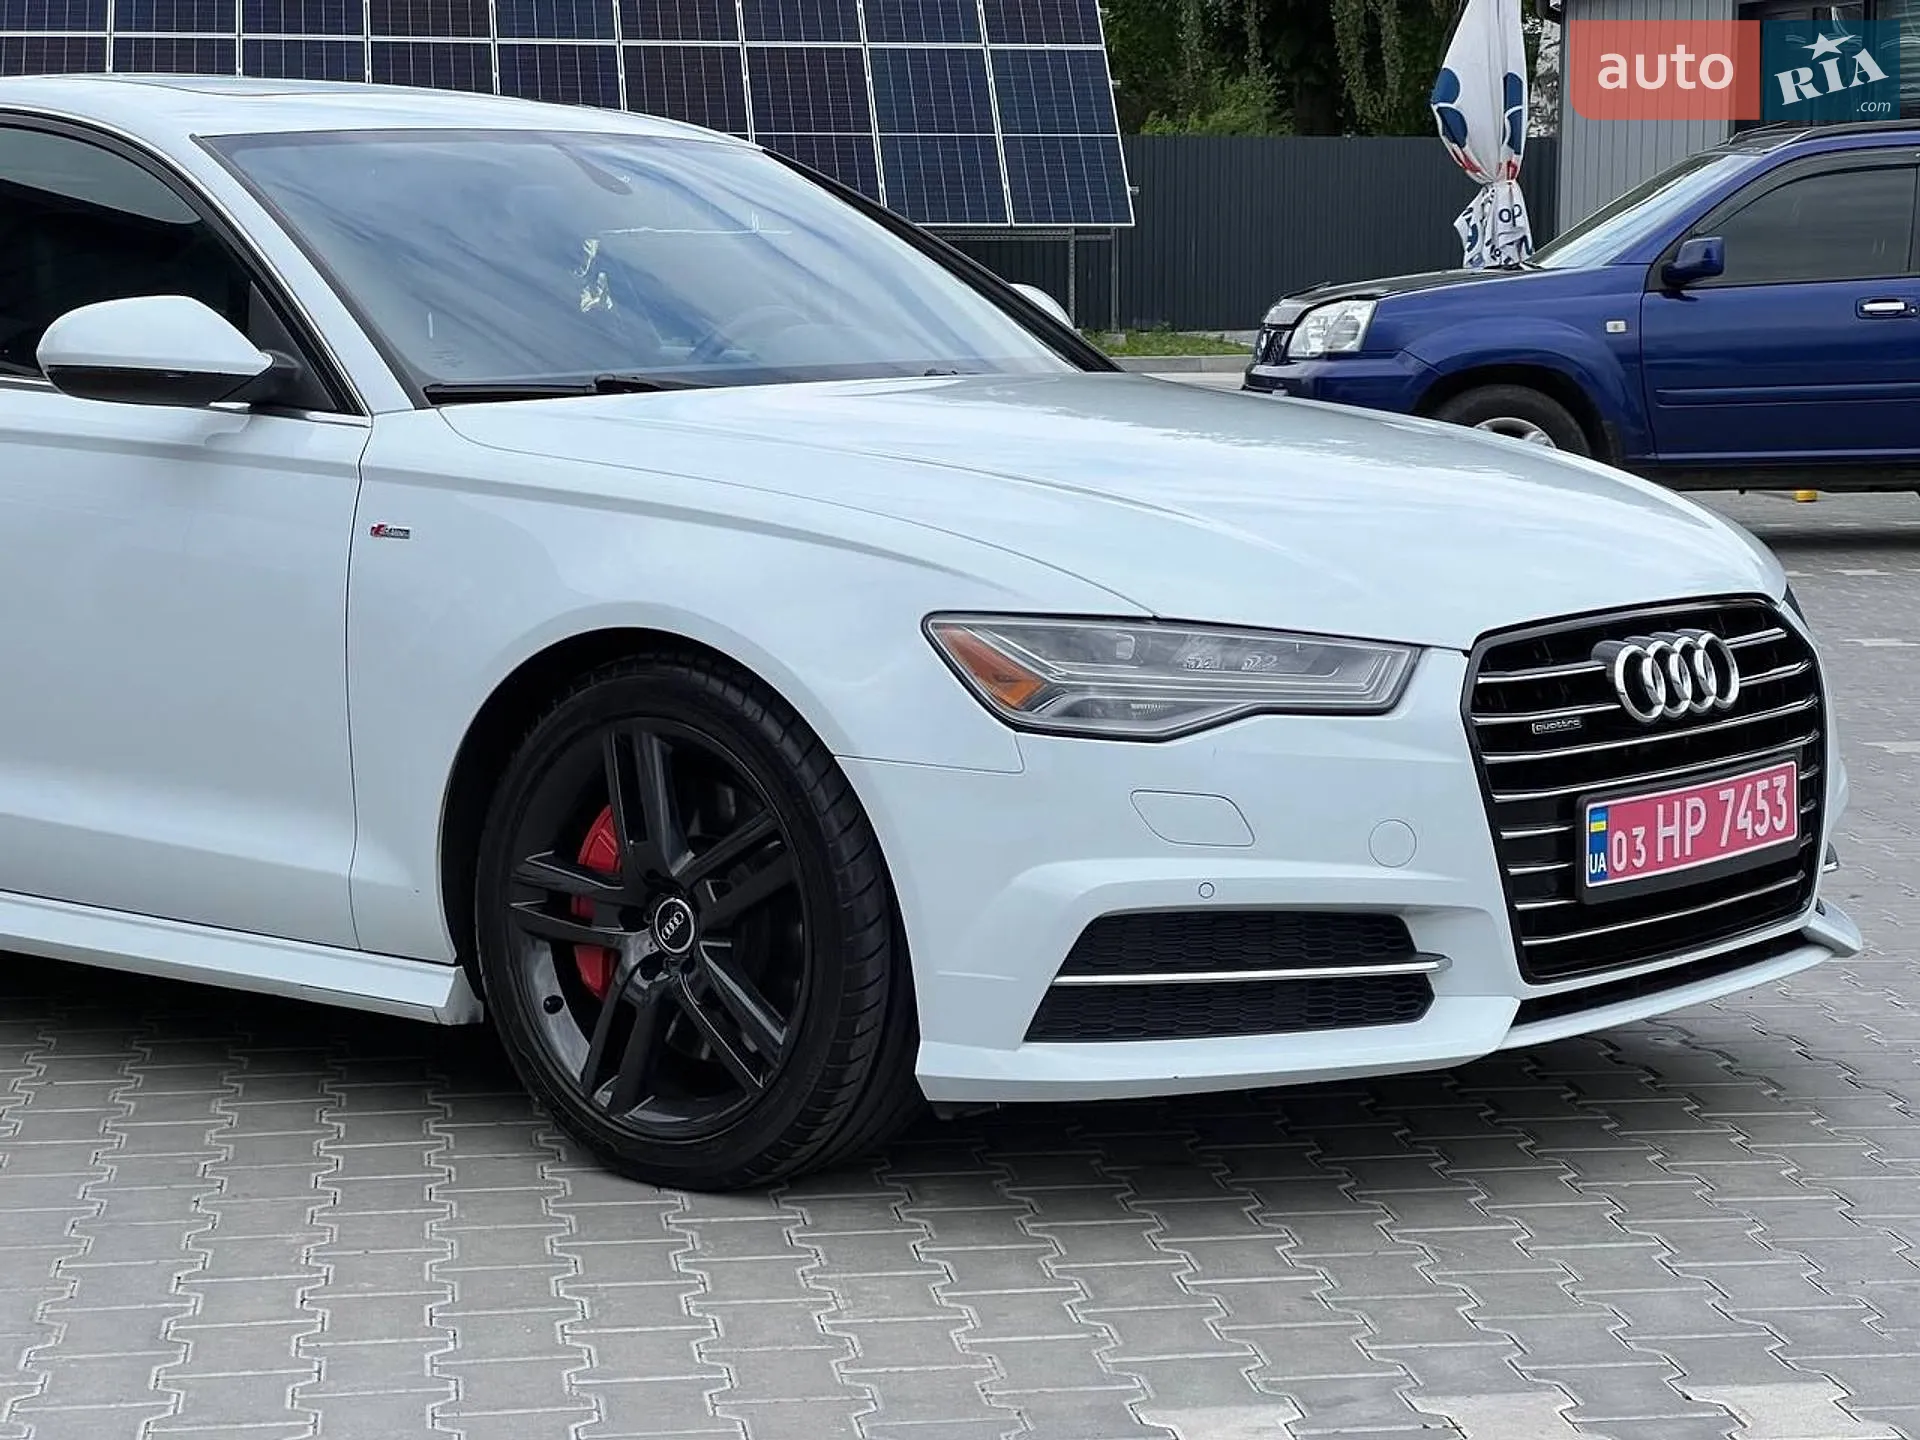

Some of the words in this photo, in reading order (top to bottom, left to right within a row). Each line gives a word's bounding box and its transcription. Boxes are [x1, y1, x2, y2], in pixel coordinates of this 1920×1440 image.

[1612, 826, 1646, 872] 03
[1656, 797, 1707, 862] HP
[1718, 774, 1788, 848] 7453
[1589, 852, 1607, 874] UA
